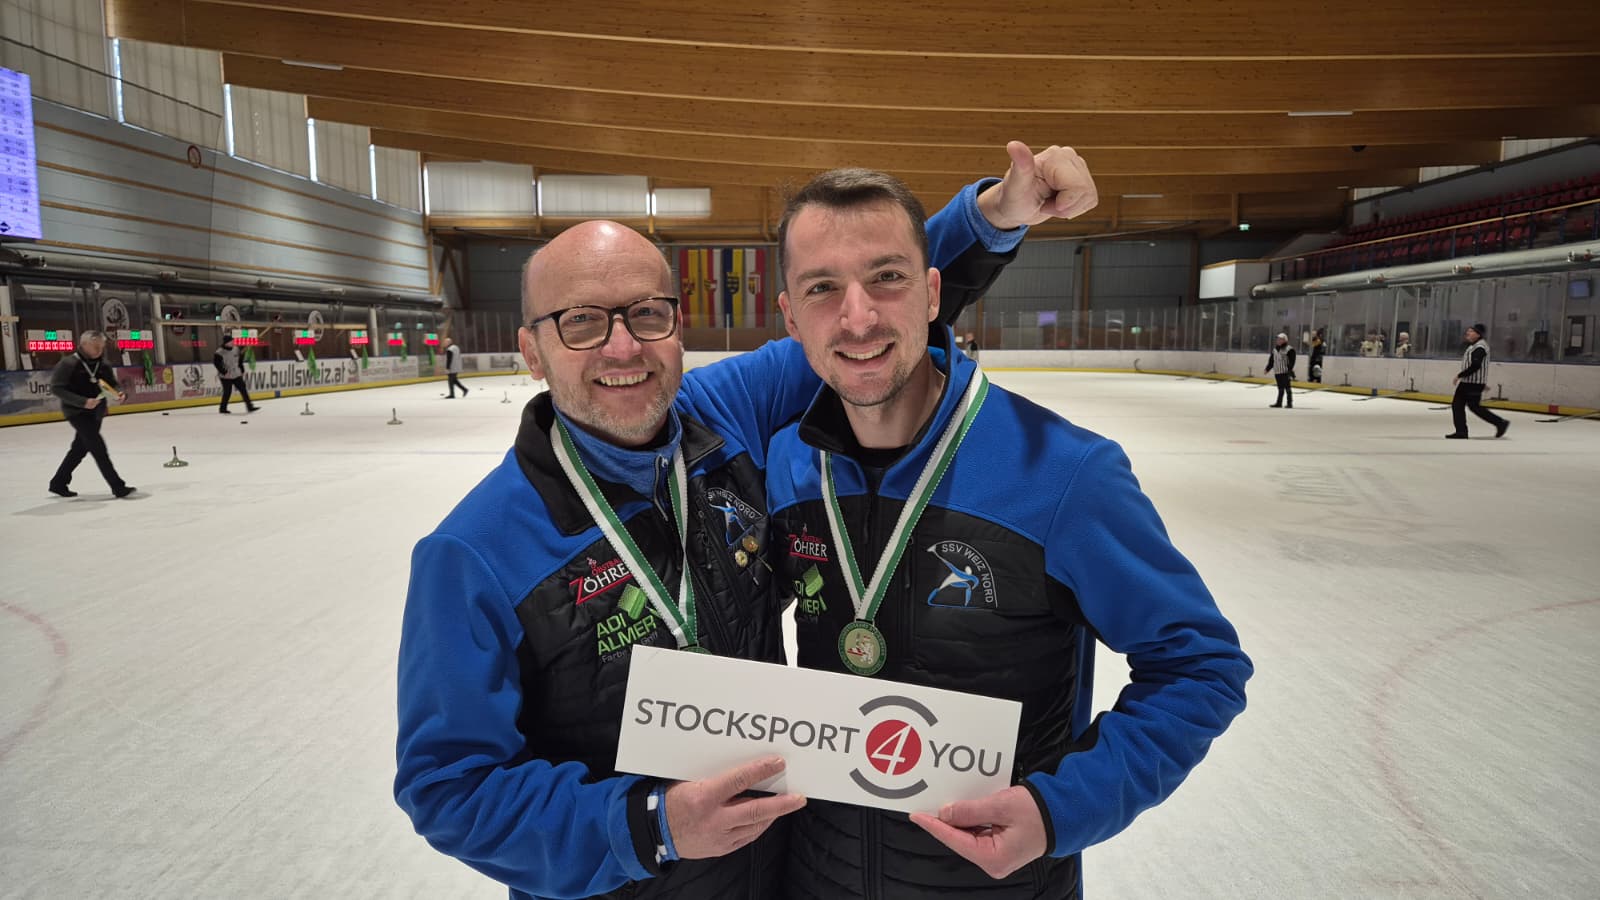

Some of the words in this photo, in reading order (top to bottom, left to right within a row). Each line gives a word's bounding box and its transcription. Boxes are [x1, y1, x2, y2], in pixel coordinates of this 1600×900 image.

[29, 381, 51, 396] Ung
[242, 361, 345, 390] ww.bullsweiz.at
[569, 562, 633, 606] ZÖHRE
[941, 543, 964, 553] SSV
[964, 547, 986, 572] WEIZ
[981, 573, 994, 603] NORD
[596, 612, 627, 639] ADI
[597, 614, 657, 656] ALMER
[635, 698, 860, 753] STOCKSPORT
[870, 723, 912, 775] 4
[929, 740, 1002, 776] YOU
